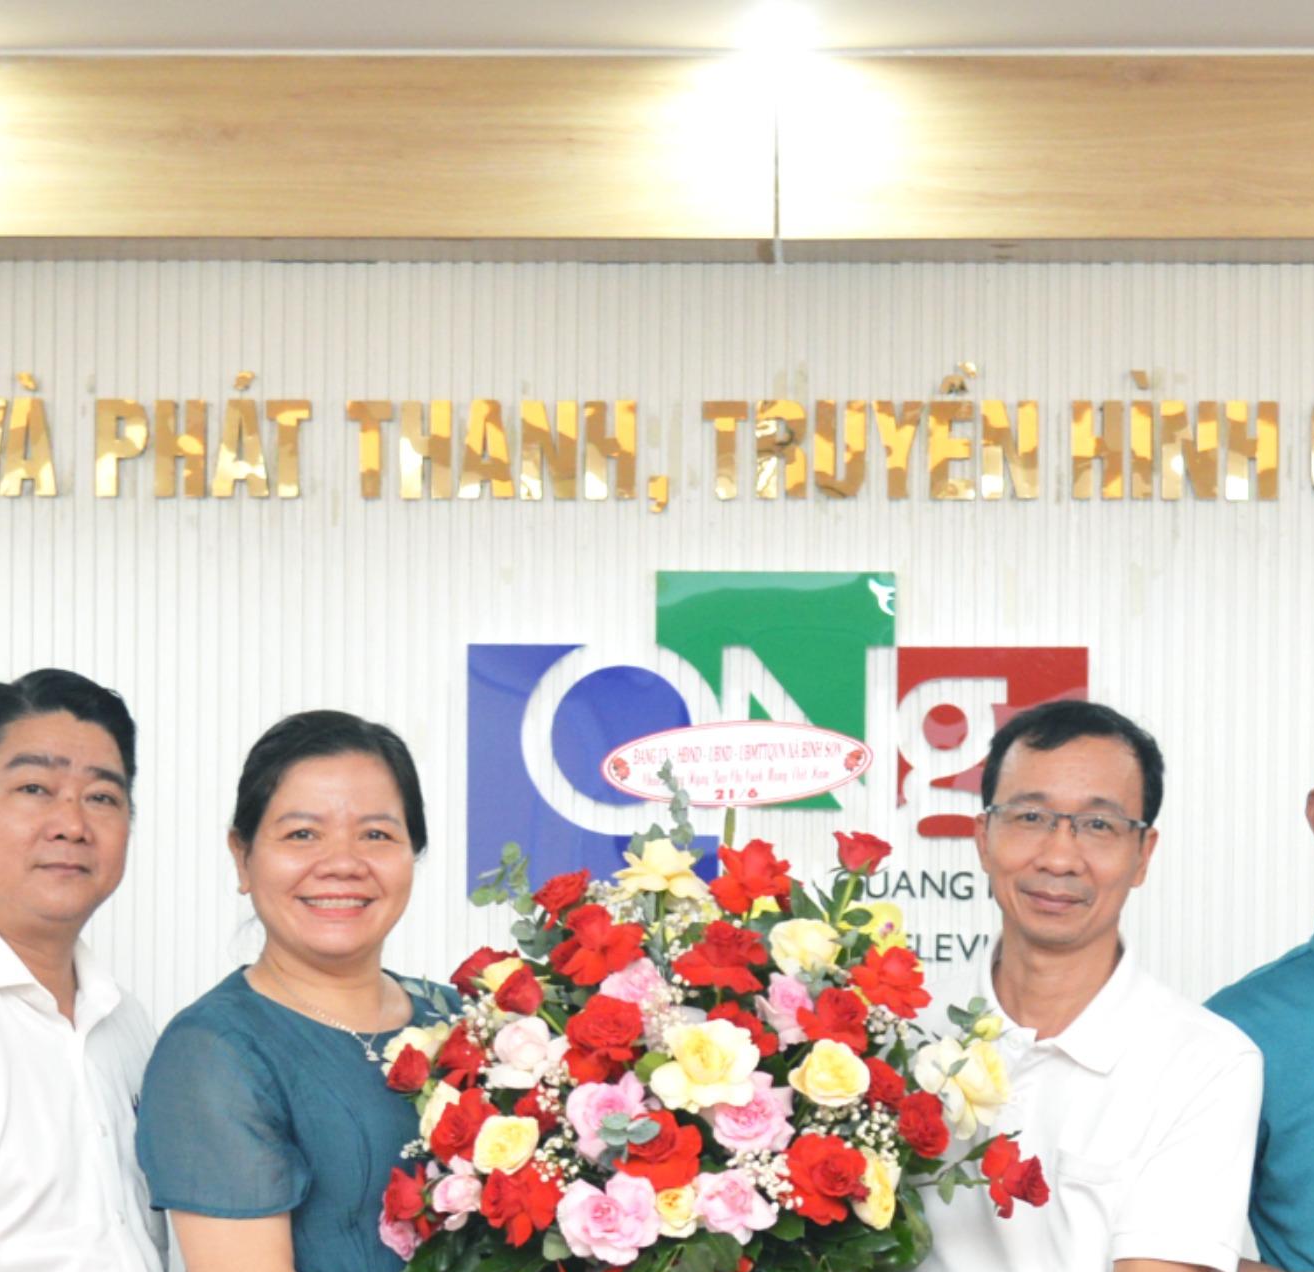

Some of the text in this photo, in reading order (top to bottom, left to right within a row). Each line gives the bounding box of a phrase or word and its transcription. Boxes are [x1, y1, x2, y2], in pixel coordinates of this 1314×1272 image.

[95, 370, 311, 498] PHÁT
[346, 399, 669, 514] THANH,
[1071, 369, 1278, 501] HÌNH
[834, 870, 975, 900] UANG
